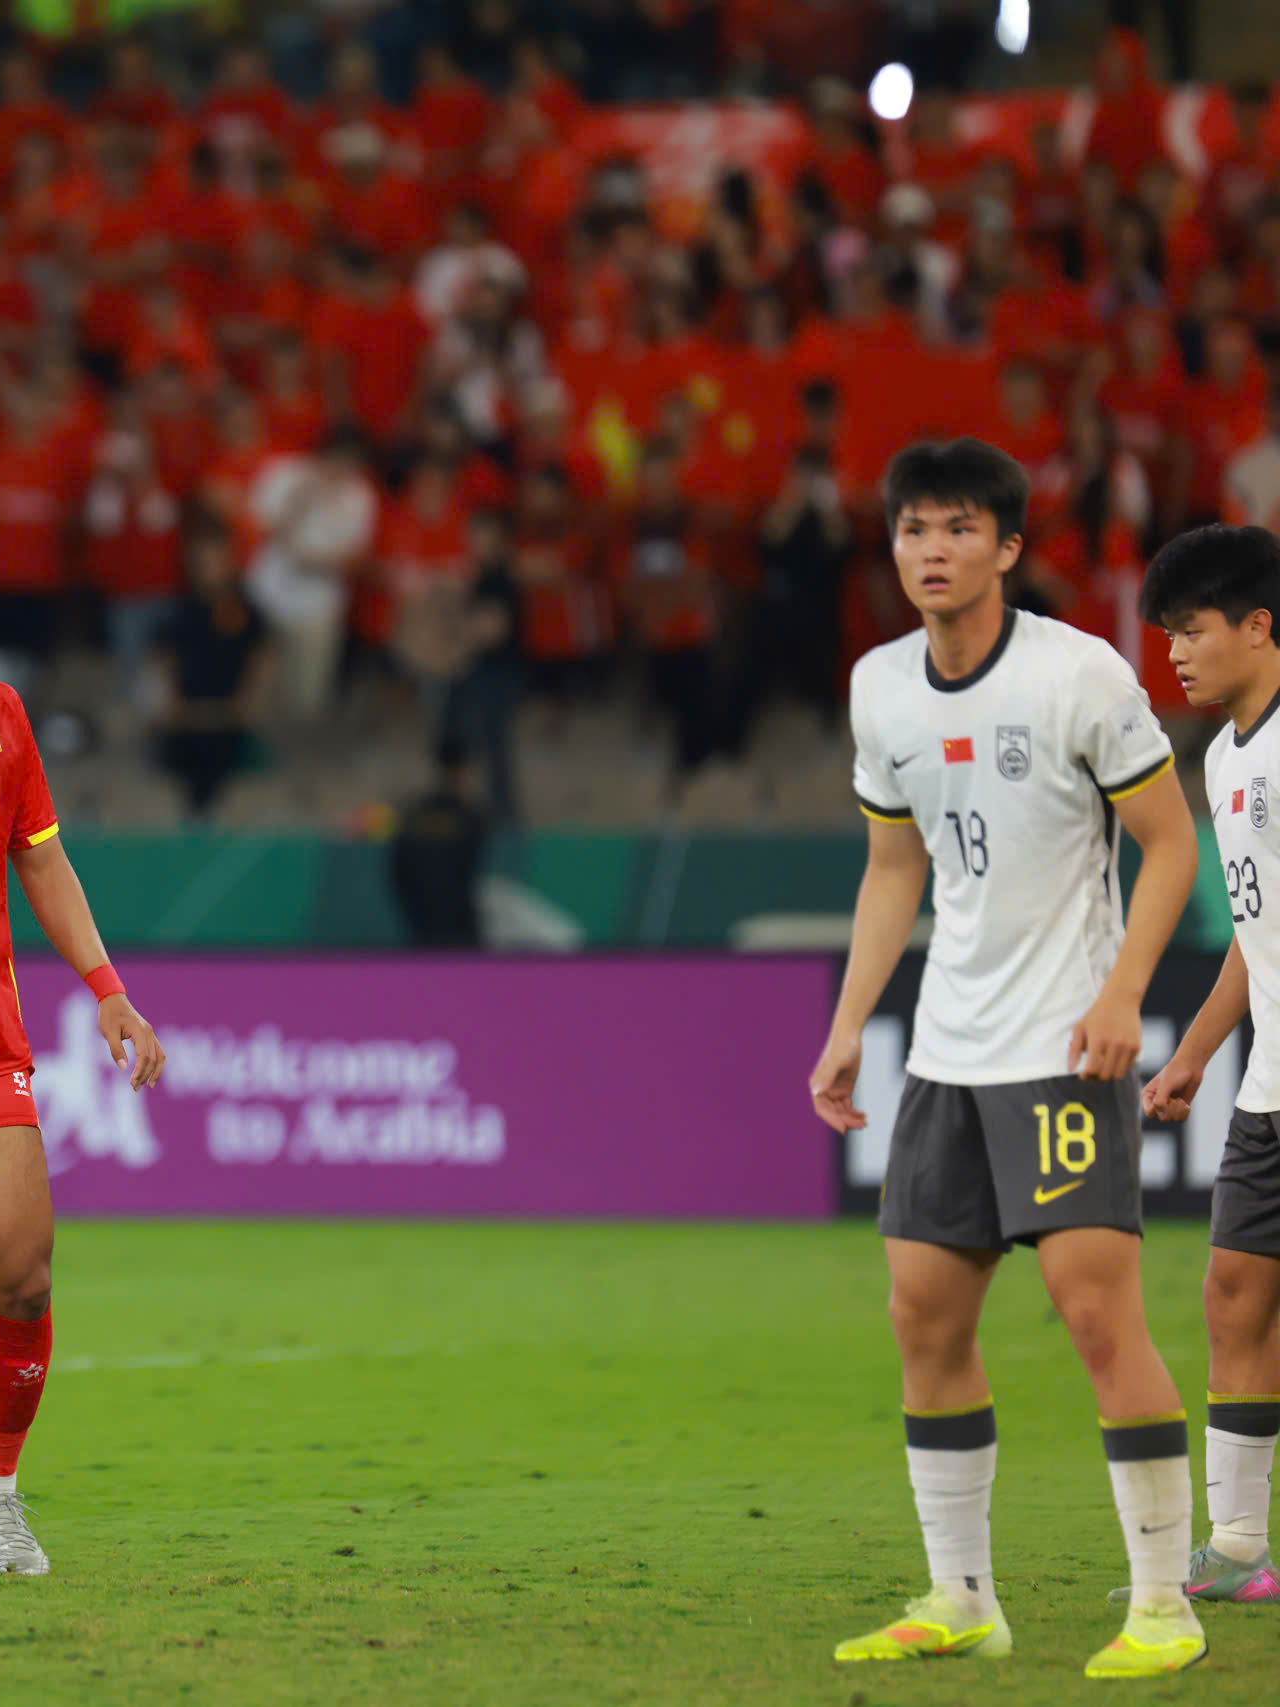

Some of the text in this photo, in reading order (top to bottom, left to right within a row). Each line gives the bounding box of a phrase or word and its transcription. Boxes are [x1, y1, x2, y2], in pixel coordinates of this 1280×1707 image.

[944, 810, 990, 877] 18
[1227, 855, 1263, 923] 23
[160, 1024, 458, 1098] Welcome
[207, 1094, 505, 1165] to Arabia
[1033, 1102, 1096, 1175] 18
